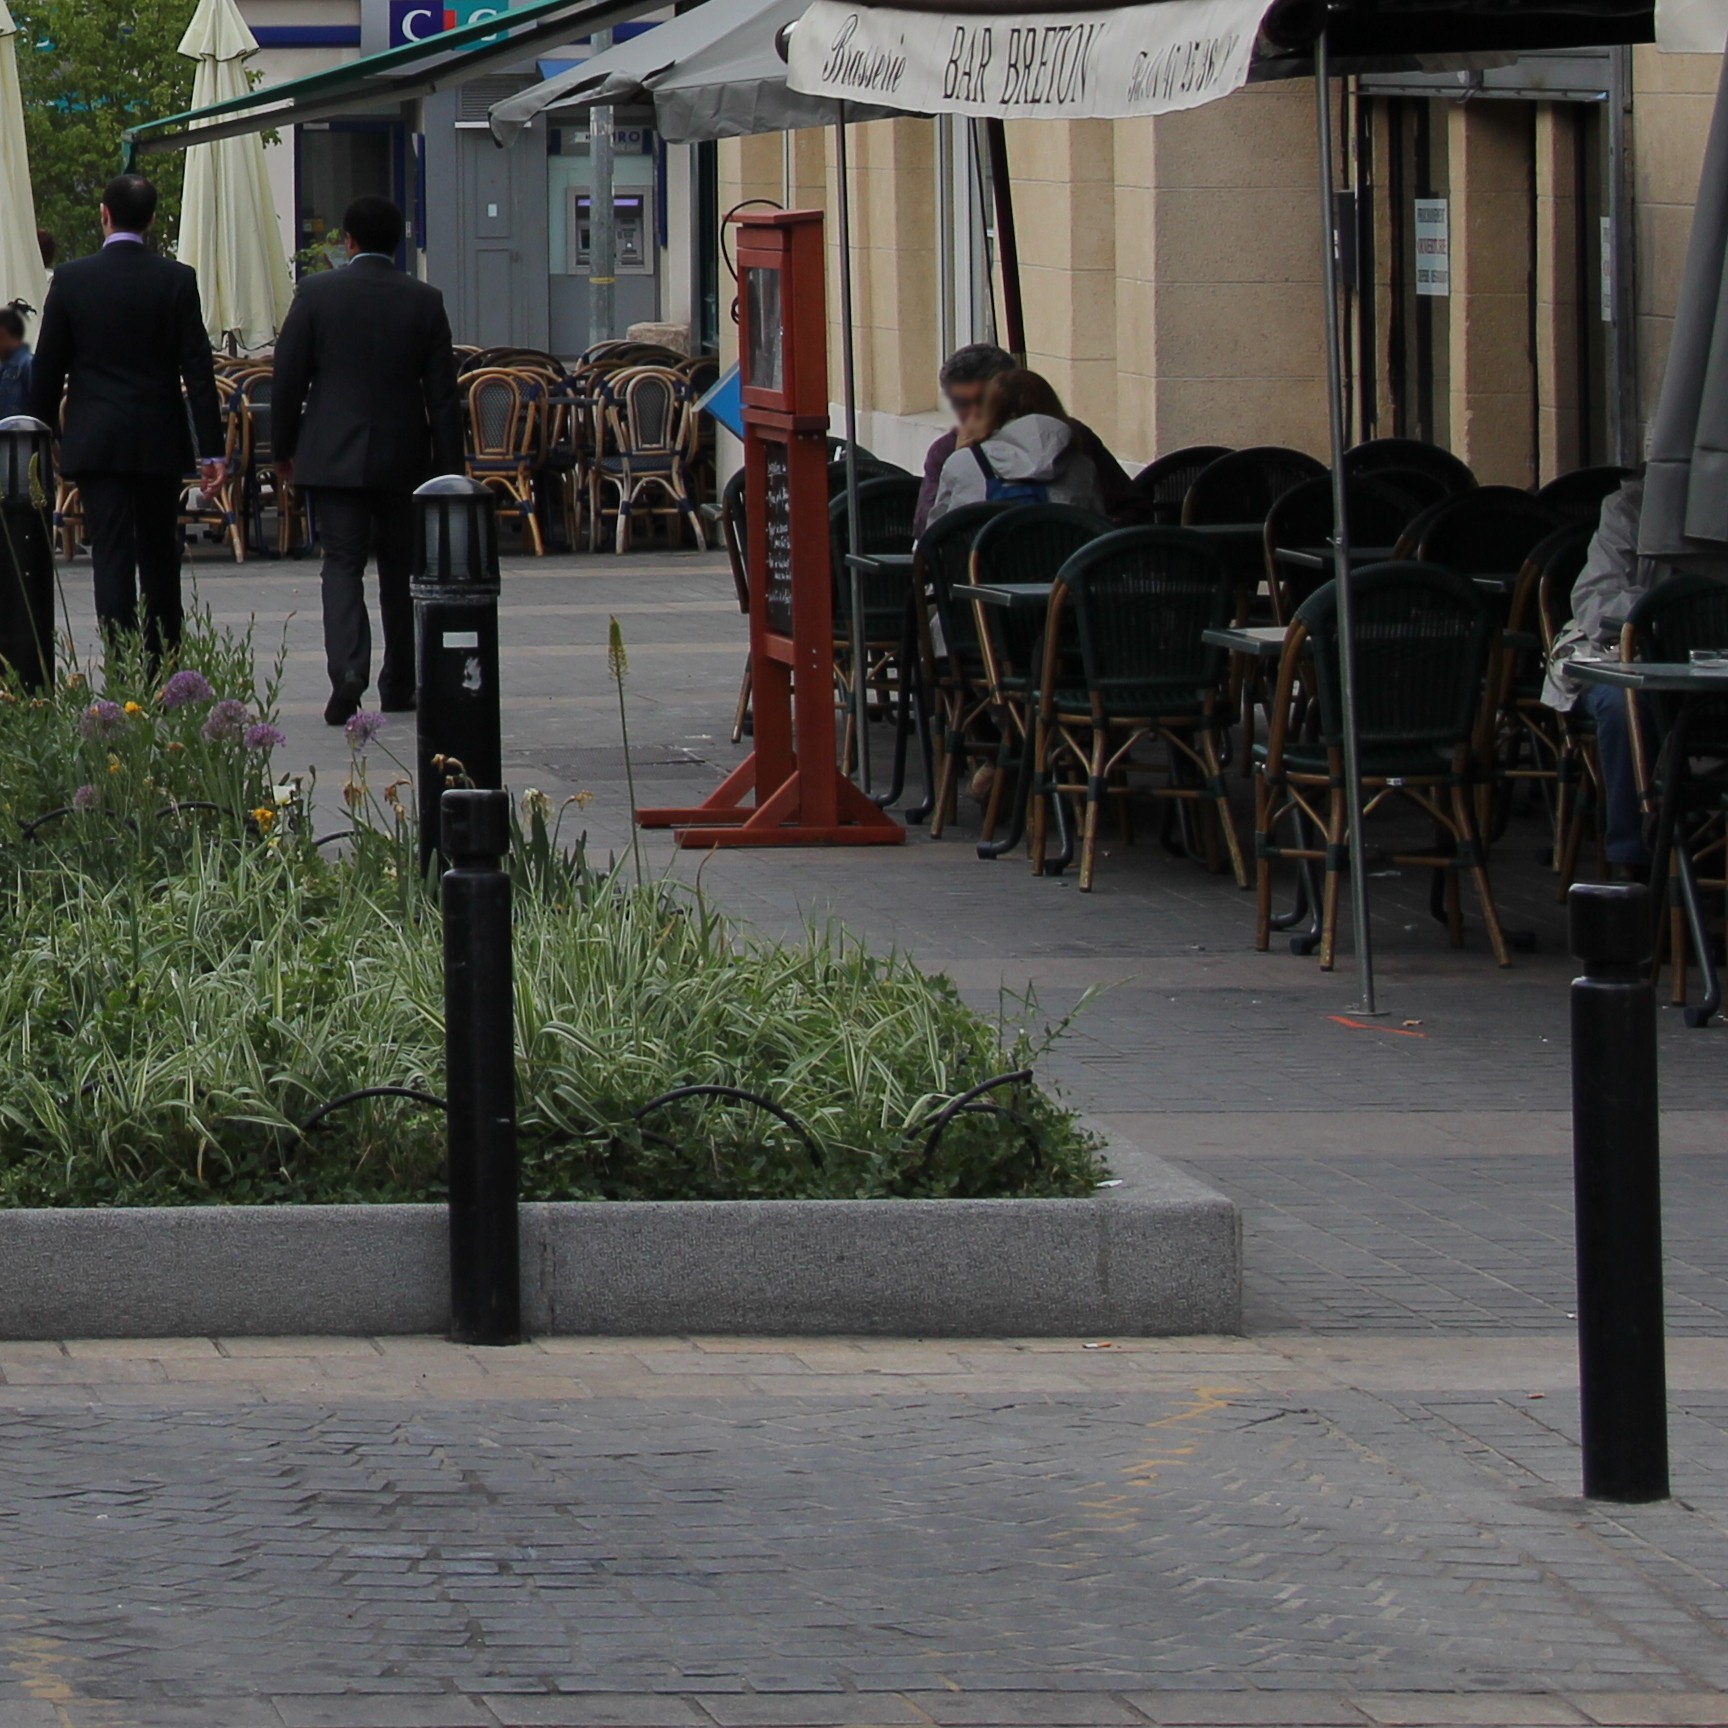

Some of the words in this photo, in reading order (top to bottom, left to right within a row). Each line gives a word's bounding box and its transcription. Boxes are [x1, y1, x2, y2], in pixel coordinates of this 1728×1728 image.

[822, 14, 908, 95] Brasserie
[942, 26, 993, 103] BAR
[999, 22, 1106, 105] BRETON
